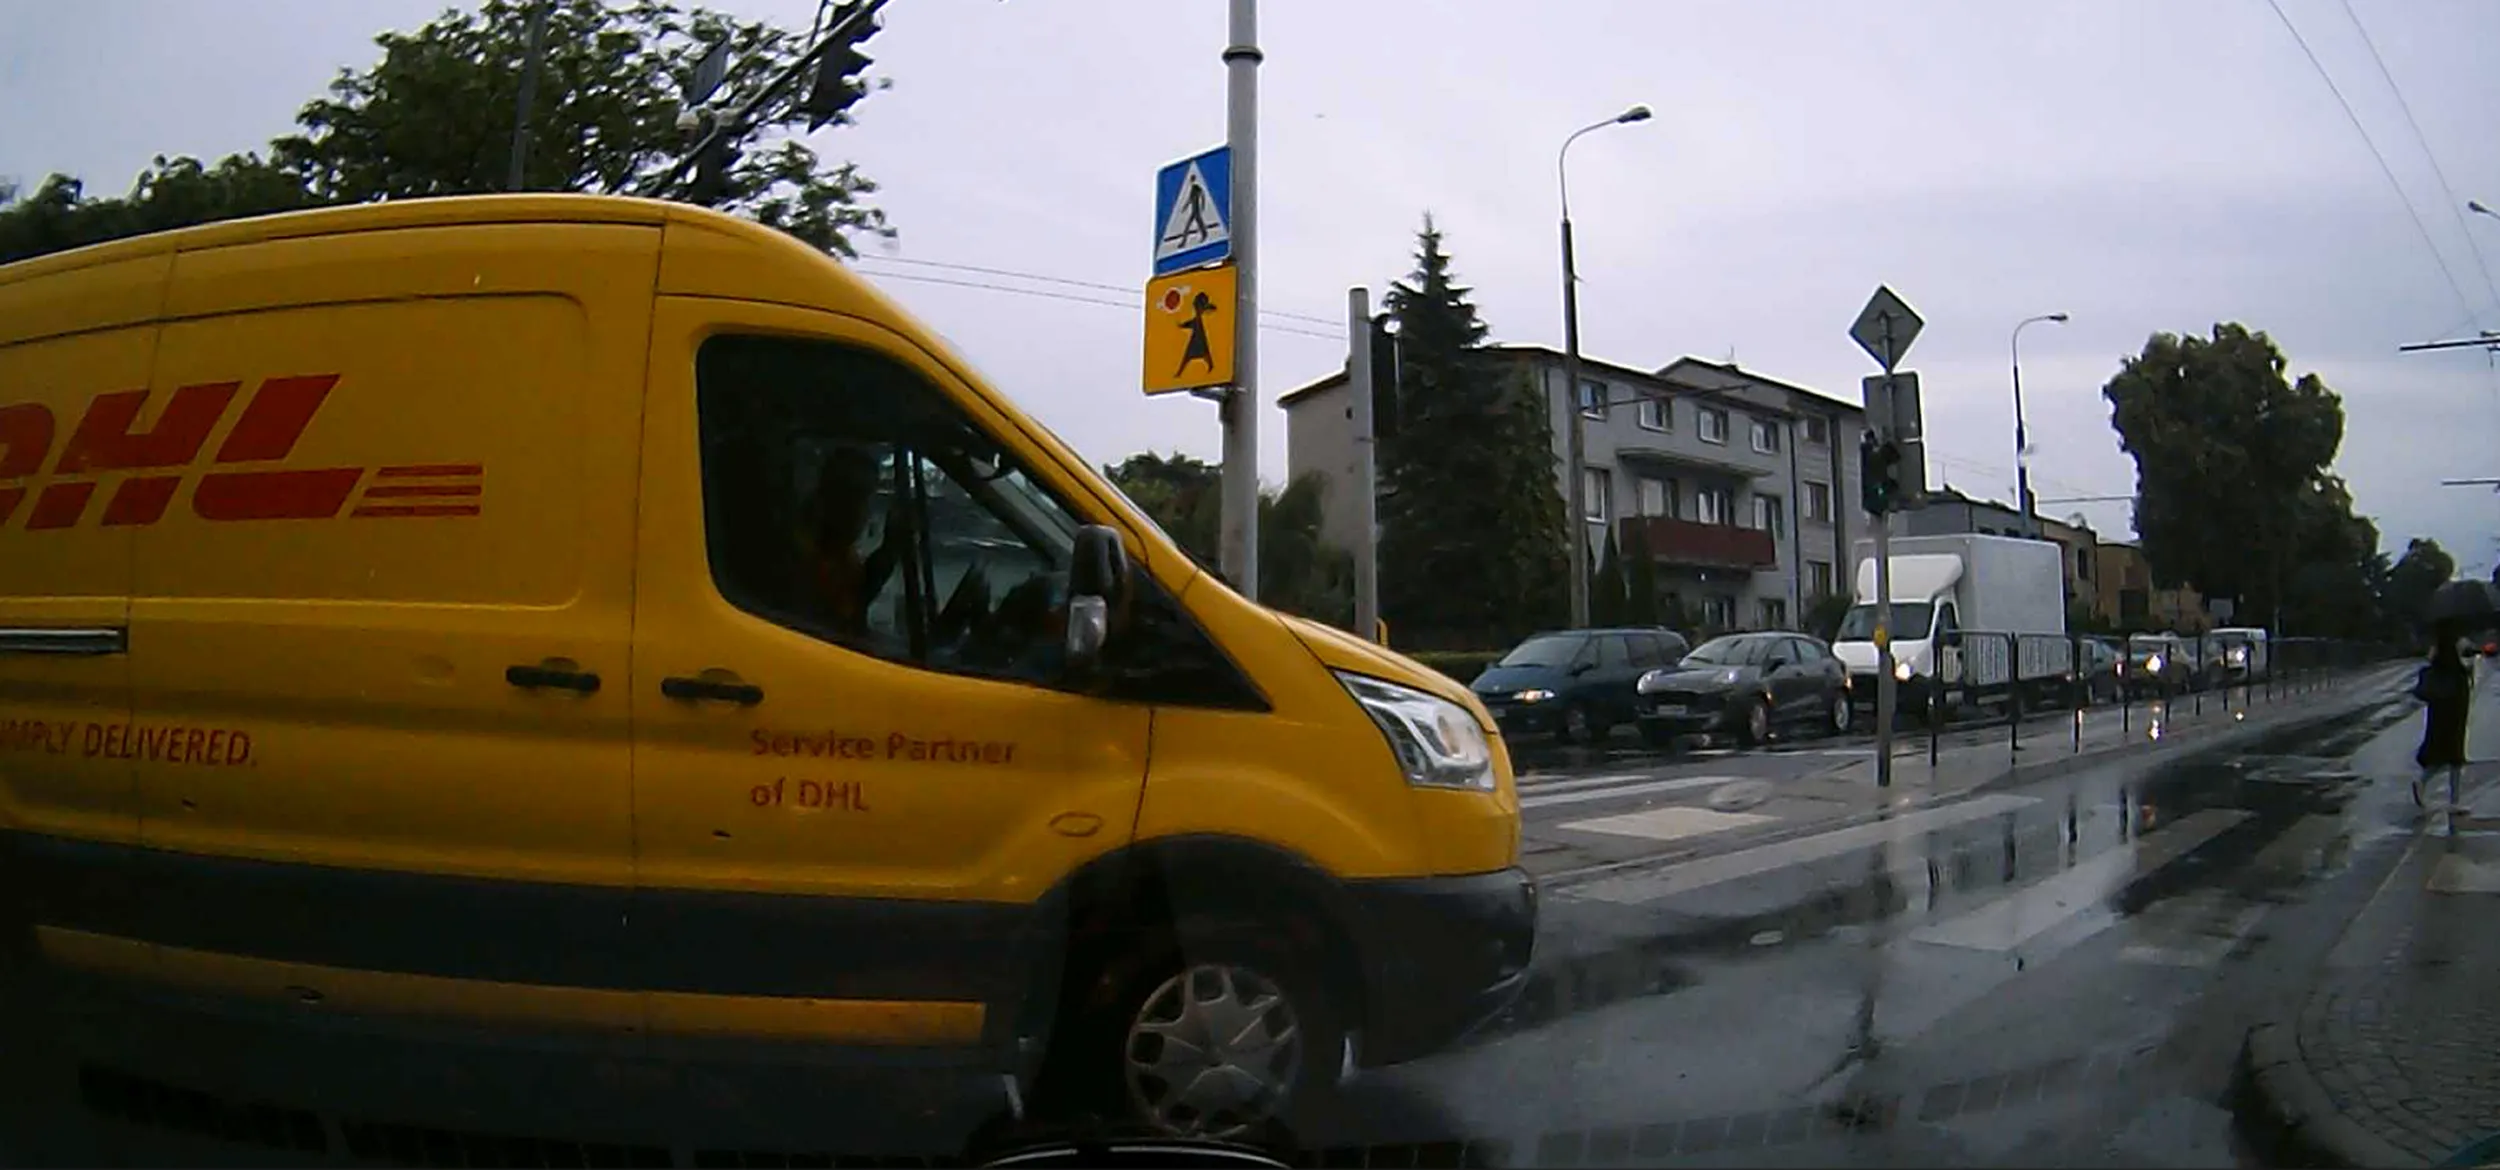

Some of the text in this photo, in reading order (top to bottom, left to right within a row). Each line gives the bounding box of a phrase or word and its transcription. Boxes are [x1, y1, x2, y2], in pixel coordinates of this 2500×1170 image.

[0, 373, 365, 530] HL
[83, 723, 257, 767] DELIVERED.
[750, 729, 1018, 764] Service Partner
[750, 776, 870, 812] of DHL
